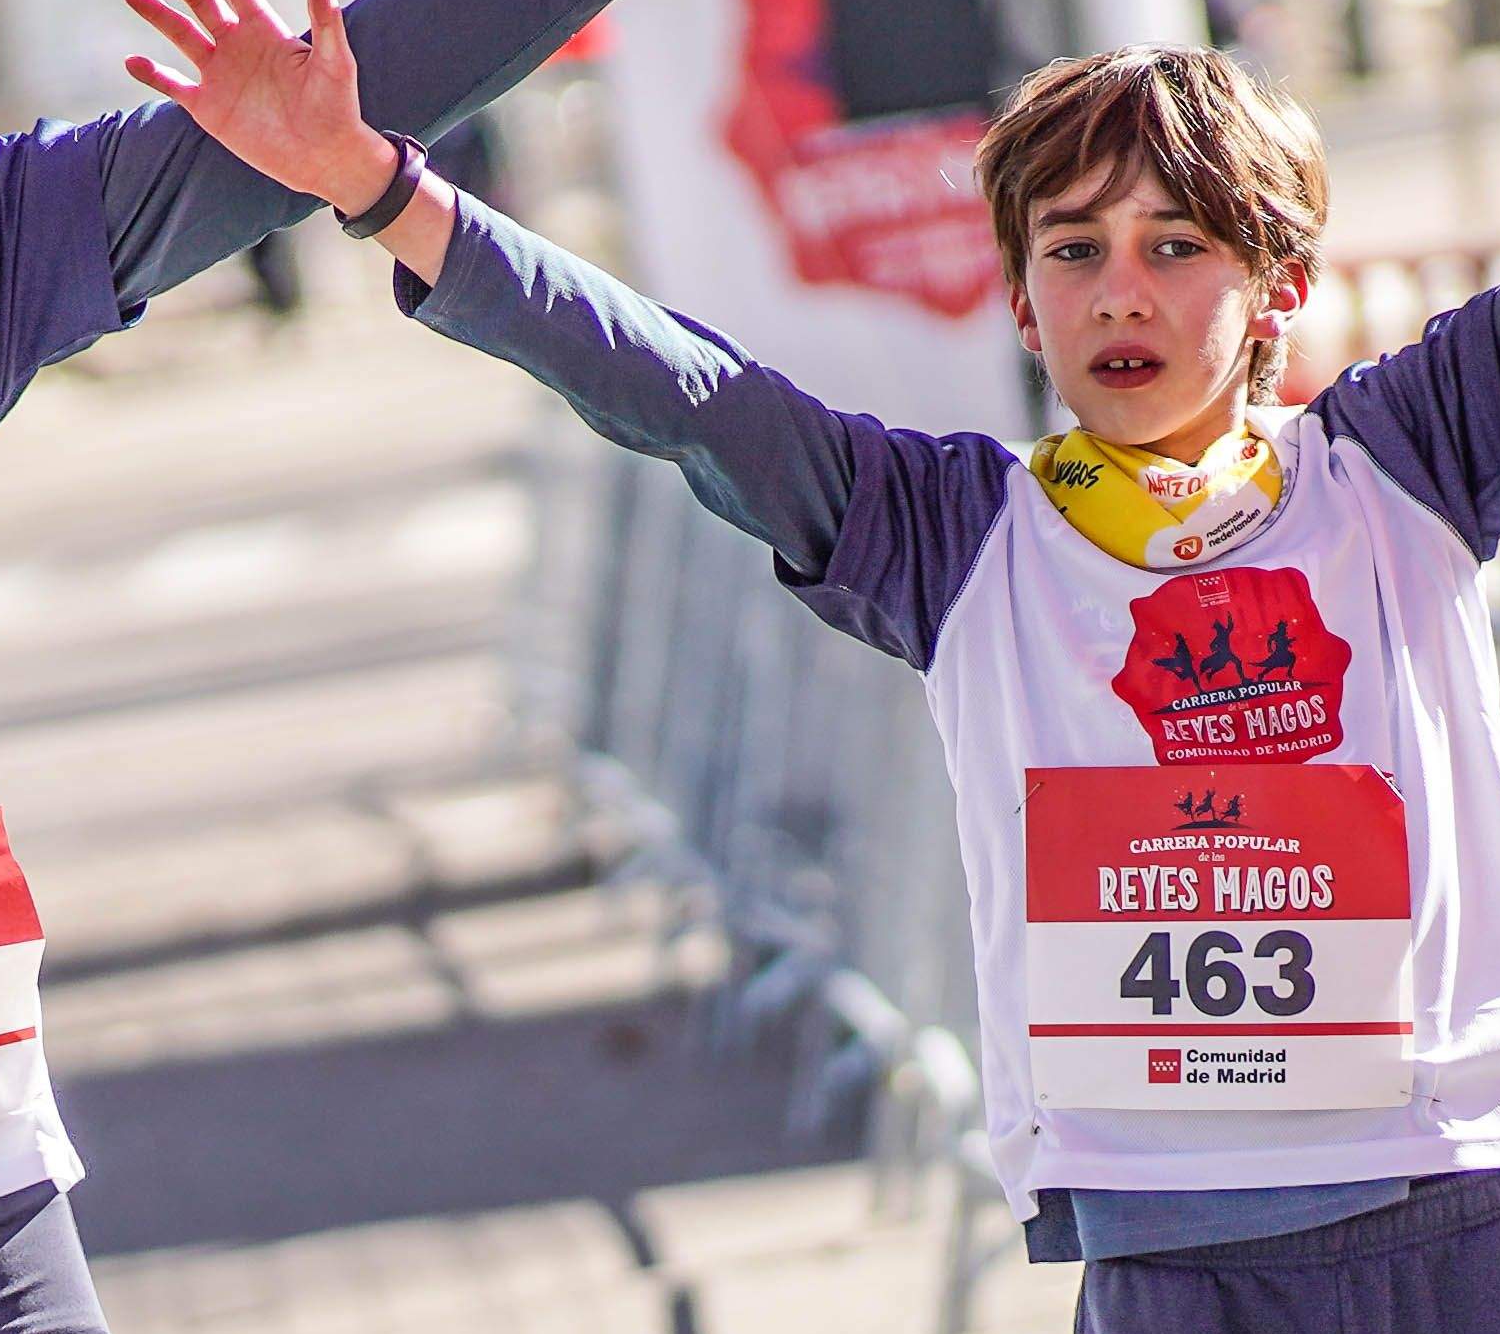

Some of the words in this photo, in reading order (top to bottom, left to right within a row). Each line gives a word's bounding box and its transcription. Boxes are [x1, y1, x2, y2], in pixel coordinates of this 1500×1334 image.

[1206, 509, 1244, 539] nationale
[1208, 508, 1261, 548] nederlanden
[1172, 690, 1236, 711] CARRERA
[1239, 680, 1303, 699] POPULAR
[1161, 714, 1236, 744] REYES
[1243, 694, 1327, 740] MAGOS
[1167, 747, 1250, 761] COMUNIDAD
[1256, 745, 1274, 756] DE
[1277, 733, 1332, 754] MADRID
[1129, 835, 1210, 855] CARRERA
[1213, 834, 1301, 854] POPULAR
[1198, 852, 1210, 862] de
[1212, 852, 1225, 862] los
[1098, 864, 1199, 913] REYES
[1214, 863, 1335, 913] MAGOS
[1120, 930, 1316, 1017] 463
[1187, 1048, 1287, 1064] Comunidad
[1187, 1068, 1211, 1084] de
[1217, 1068, 1287, 1084] Madrid
